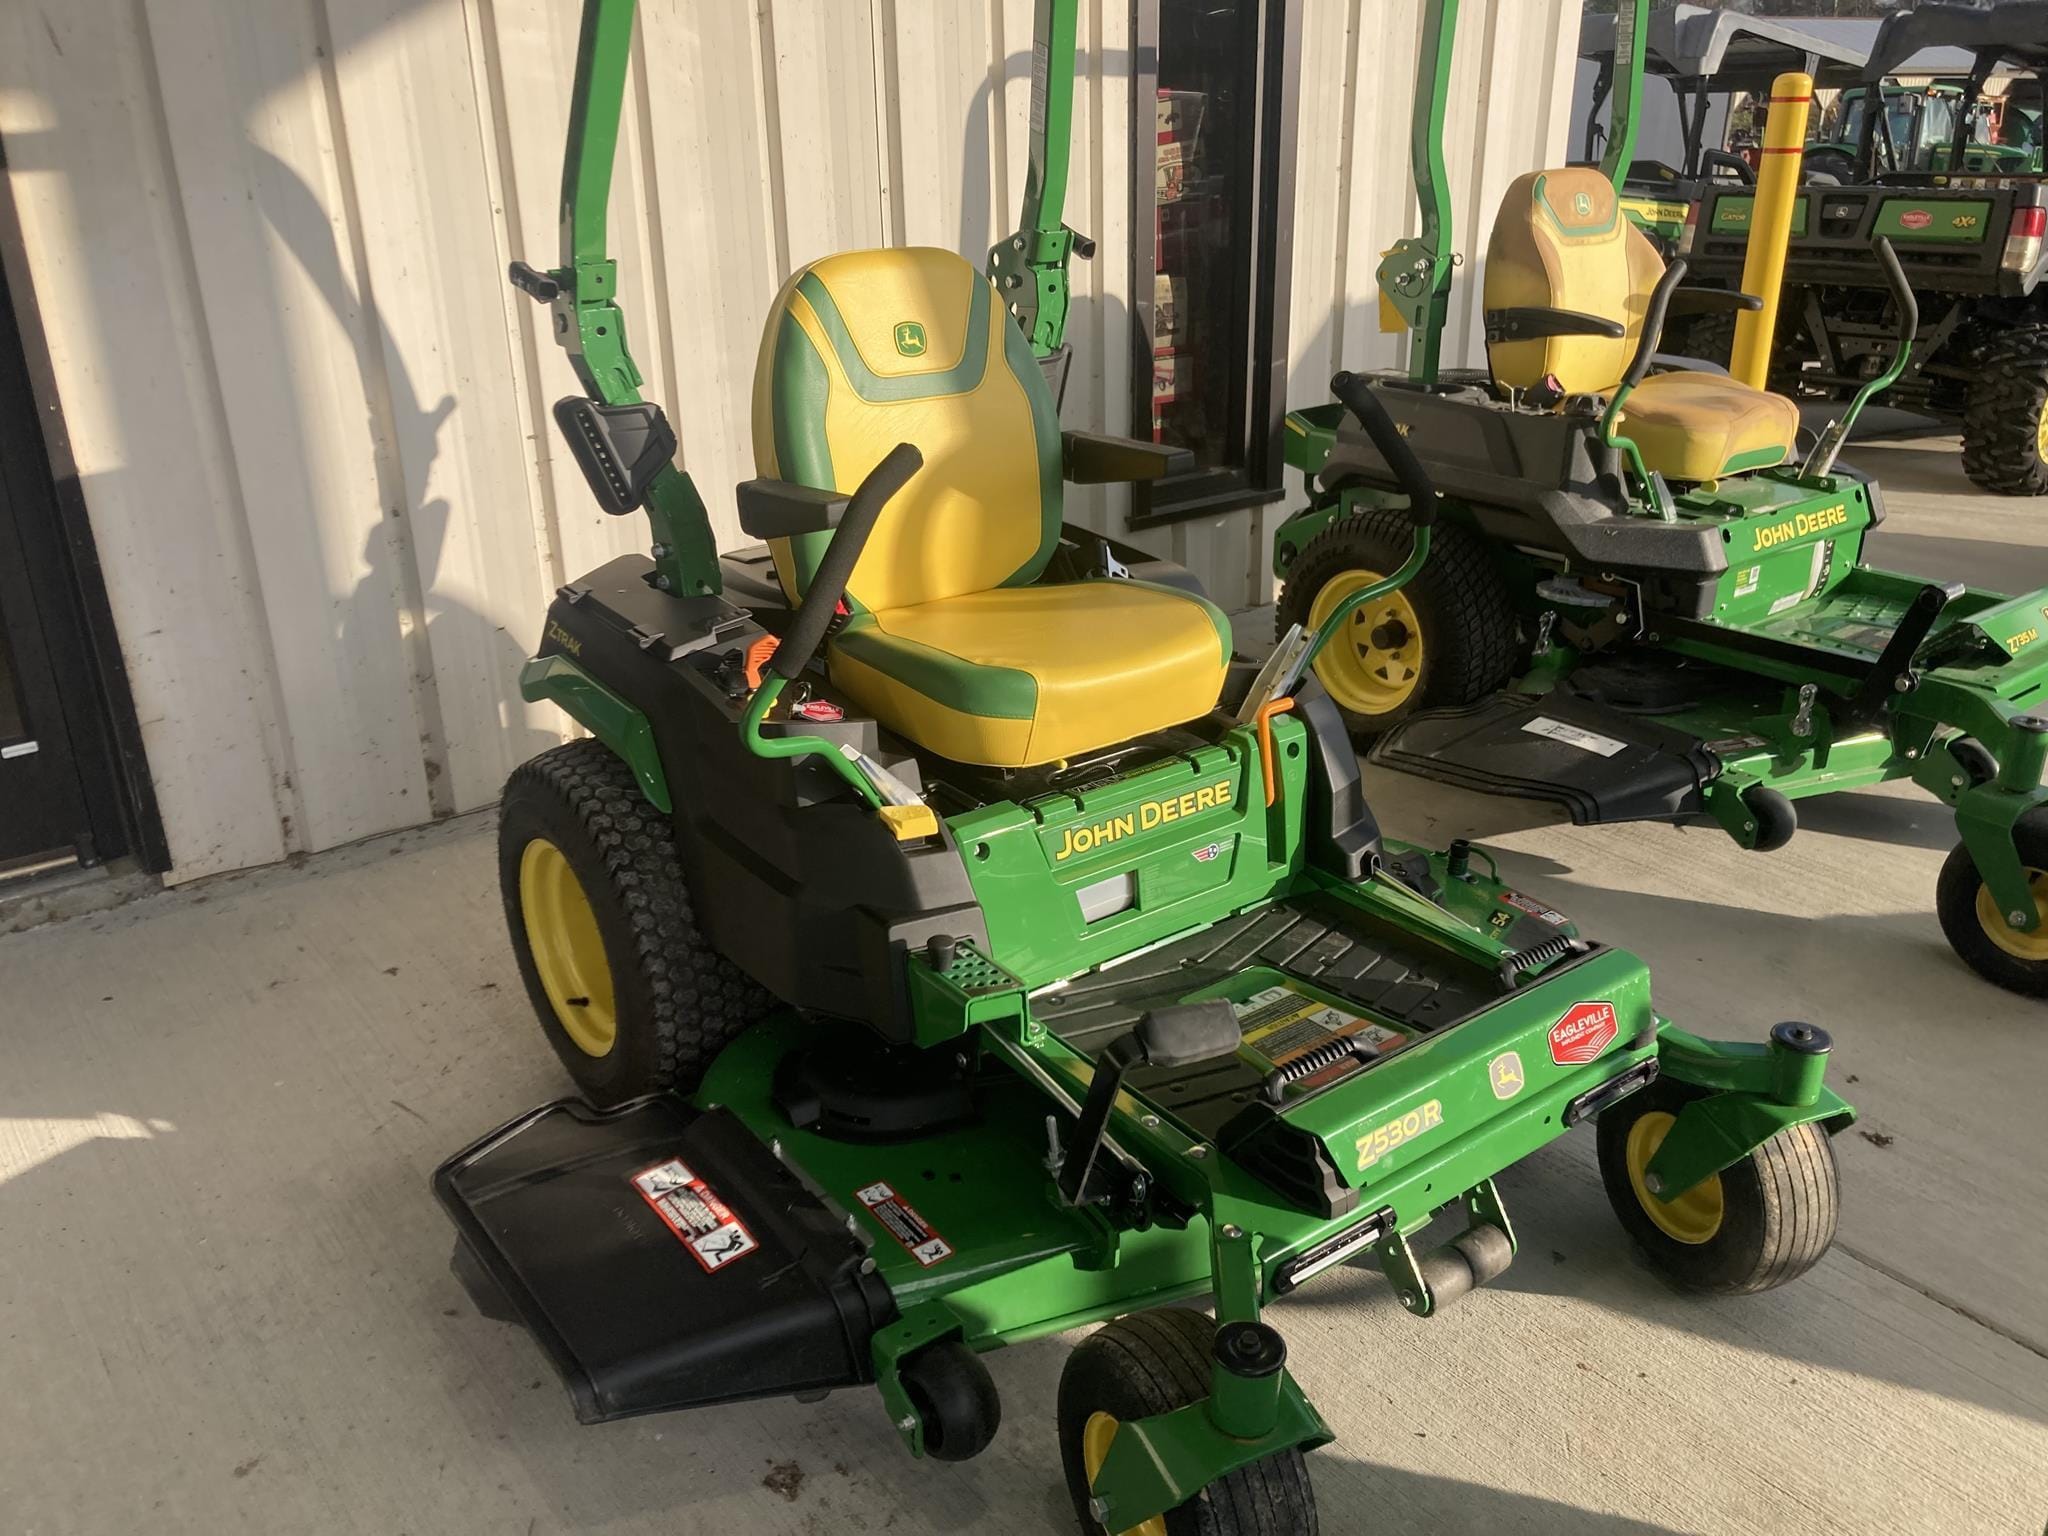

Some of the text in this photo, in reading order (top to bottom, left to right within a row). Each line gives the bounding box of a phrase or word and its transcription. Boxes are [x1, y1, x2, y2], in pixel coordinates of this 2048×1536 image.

[1753, 504, 1848, 552] JOHN DEERE
[1056, 813, 1135, 861] JOHN
[1139, 780, 1233, 831] DEERE
[1553, 1006, 1611, 1043] EAGLEVILLE
